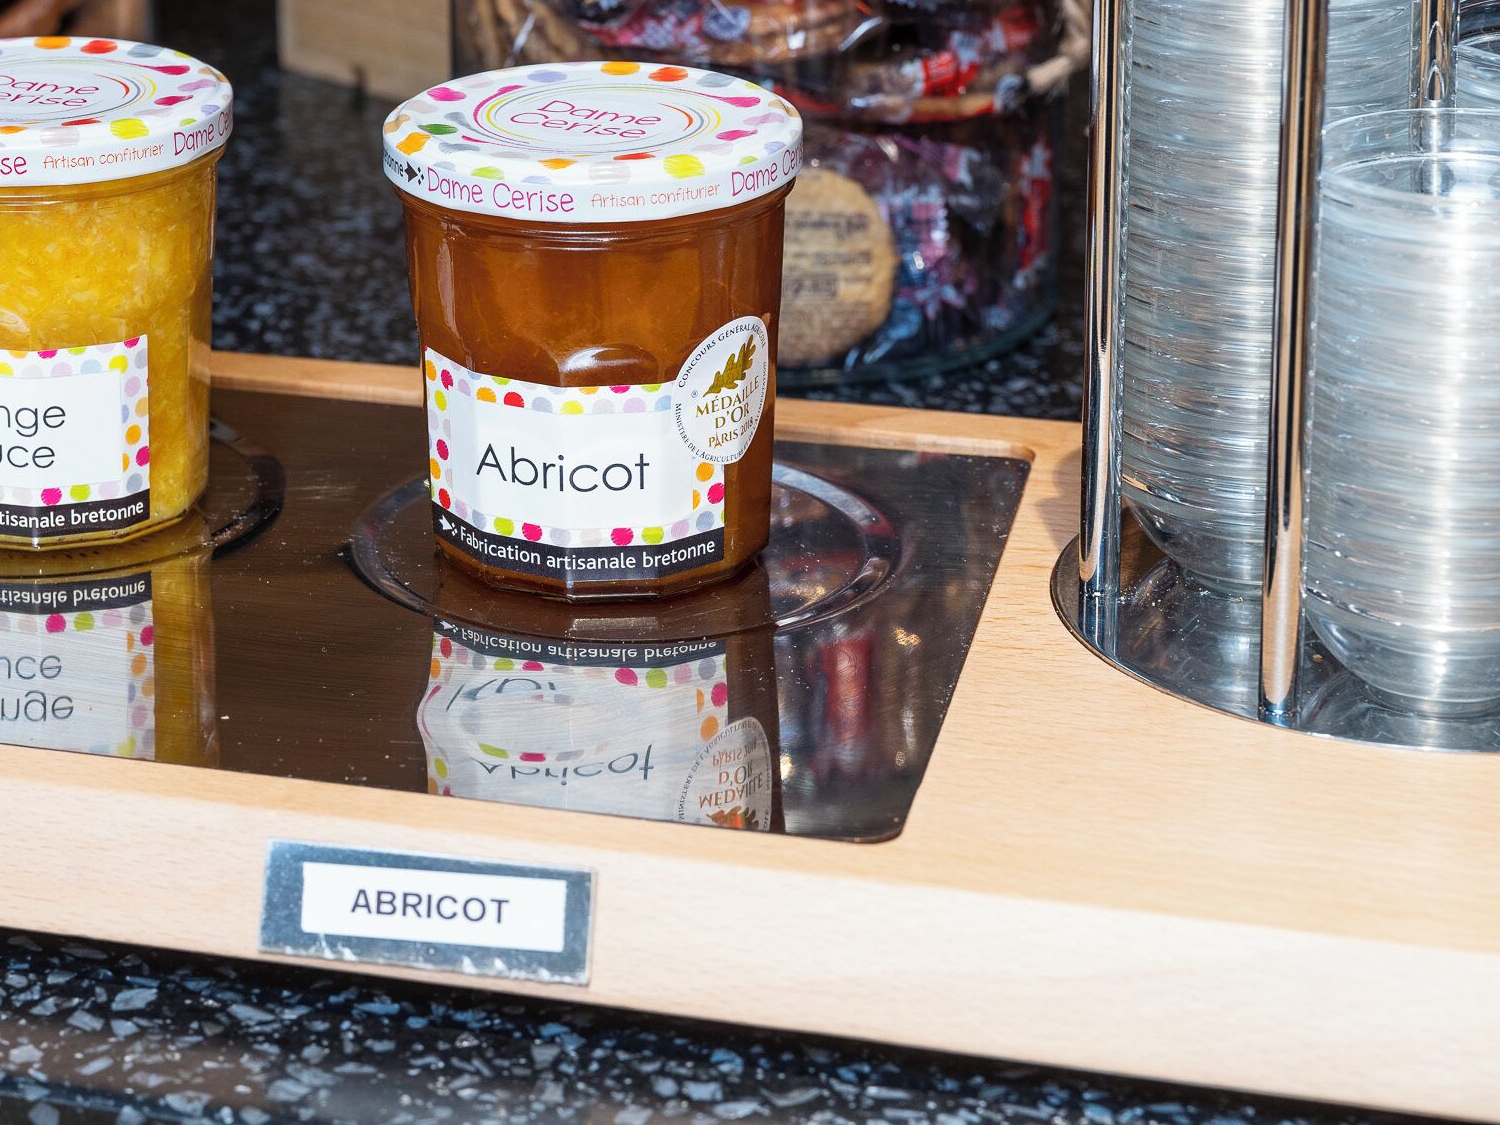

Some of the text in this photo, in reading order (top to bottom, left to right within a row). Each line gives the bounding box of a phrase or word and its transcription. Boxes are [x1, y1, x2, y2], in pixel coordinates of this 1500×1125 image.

[510, 112, 647, 139] Cerise
[538, 100, 661, 126] Dame
[44, 154, 95, 169] Artisan
[99, 143, 164, 166] confiturier
[173, 123, 215, 156] Dame
[427, 166, 483, 204] Dame
[493, 183, 574, 212] Cerise
[592, 193, 646, 208] Artisan
[650, 181, 720, 205] confiturier
[731, 162, 778, 196] Dame
[678, 340, 717, 388] CONCOURS
[696, 375, 759, 417] MÉDAILLE
[715, 403, 749, 429] D'OR
[476, 443, 650, 492] Abricot
[71, 500, 144, 525] bretonne
[460, 526, 715, 571] Fabrication artisanale bretonne
[350, 889, 509, 924] ABRICOT
